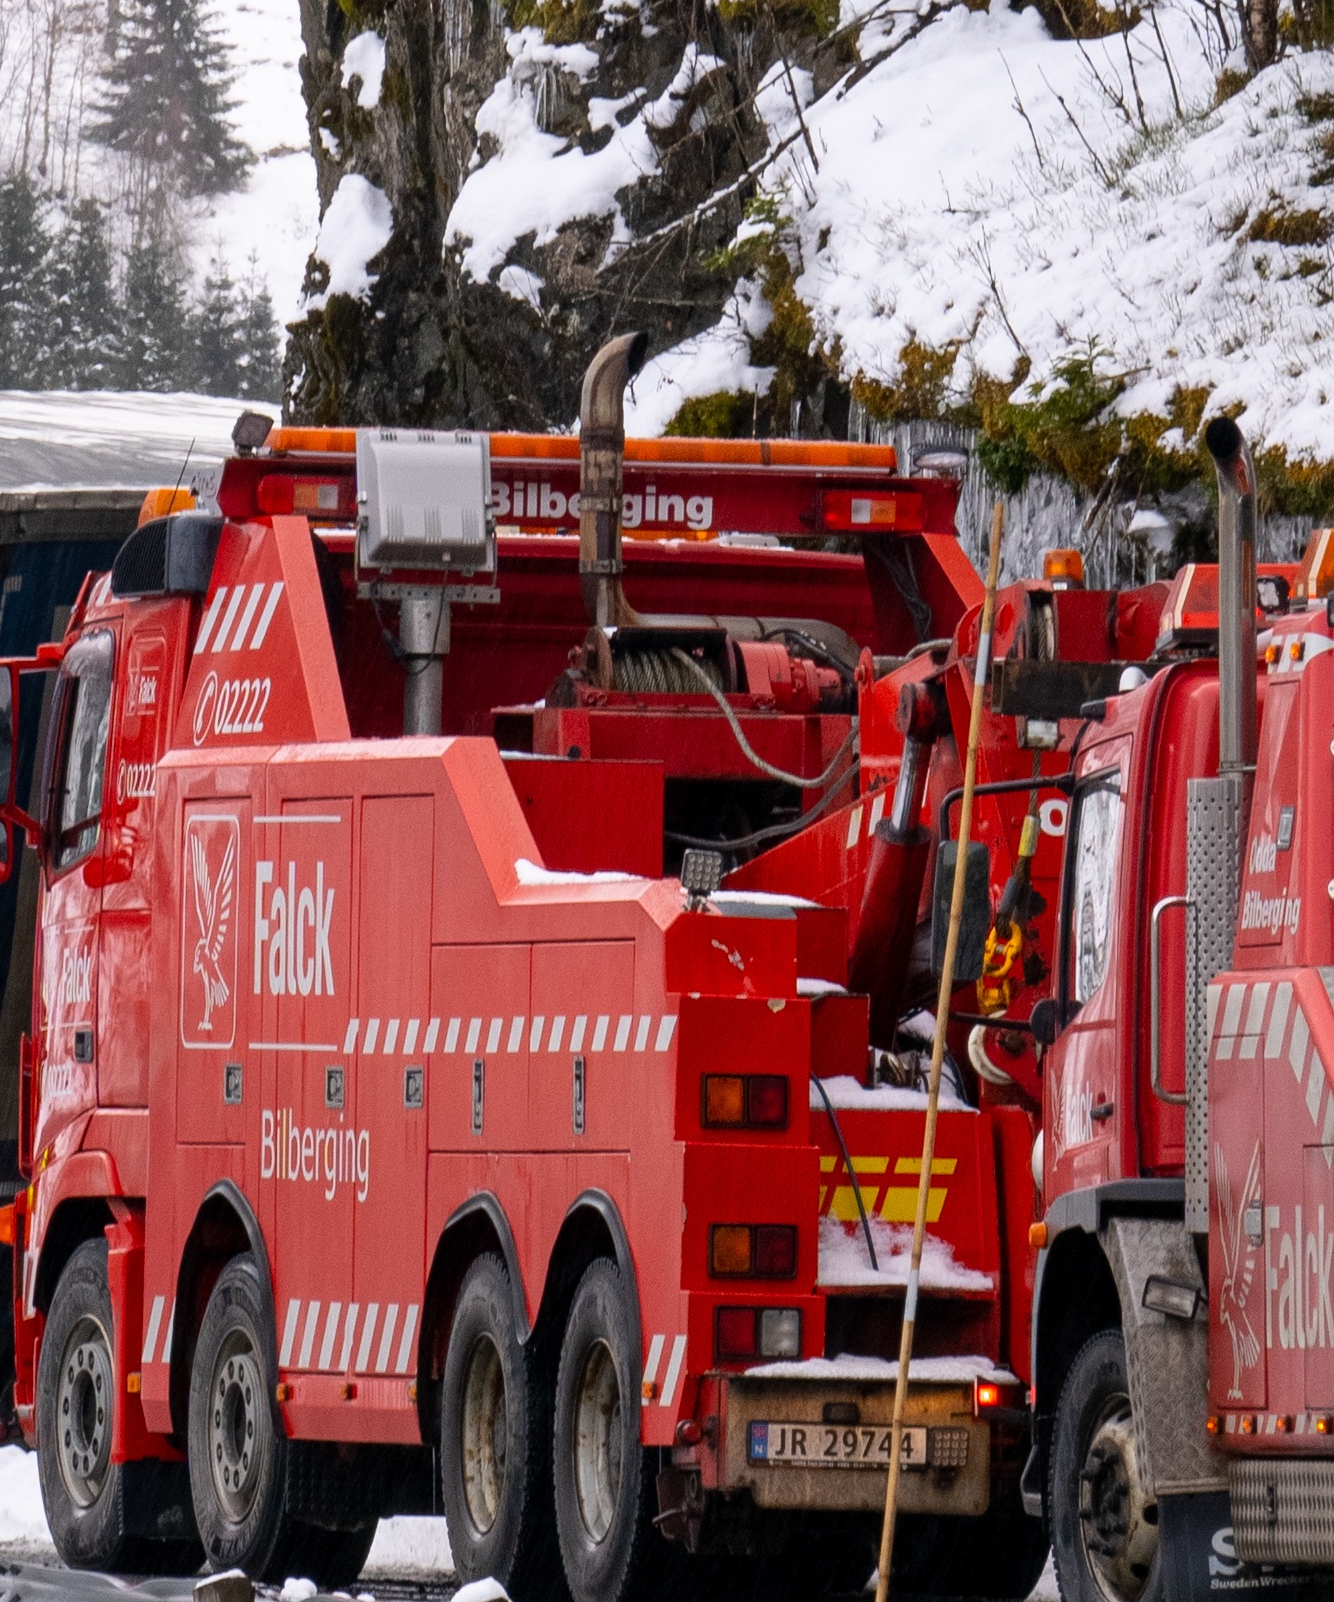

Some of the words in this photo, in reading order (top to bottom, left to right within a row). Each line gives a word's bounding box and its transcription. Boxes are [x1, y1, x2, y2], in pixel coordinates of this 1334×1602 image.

[491, 480, 714, 531] Bilbging
[214, 677, 271, 735] 02222
[127, 763, 157, 797] 02222
[253, 860, 335, 997] Falck
[1241, 887, 1301, 936] Bilberging
[61, 945, 91, 1004] Falck
[261, 1107, 371, 1203] Bilberging
[775, 1428, 807, 1456] JR
[823, 1429, 915, 1459] 29744
[1210, 1578, 1259, 1590] Sweden
